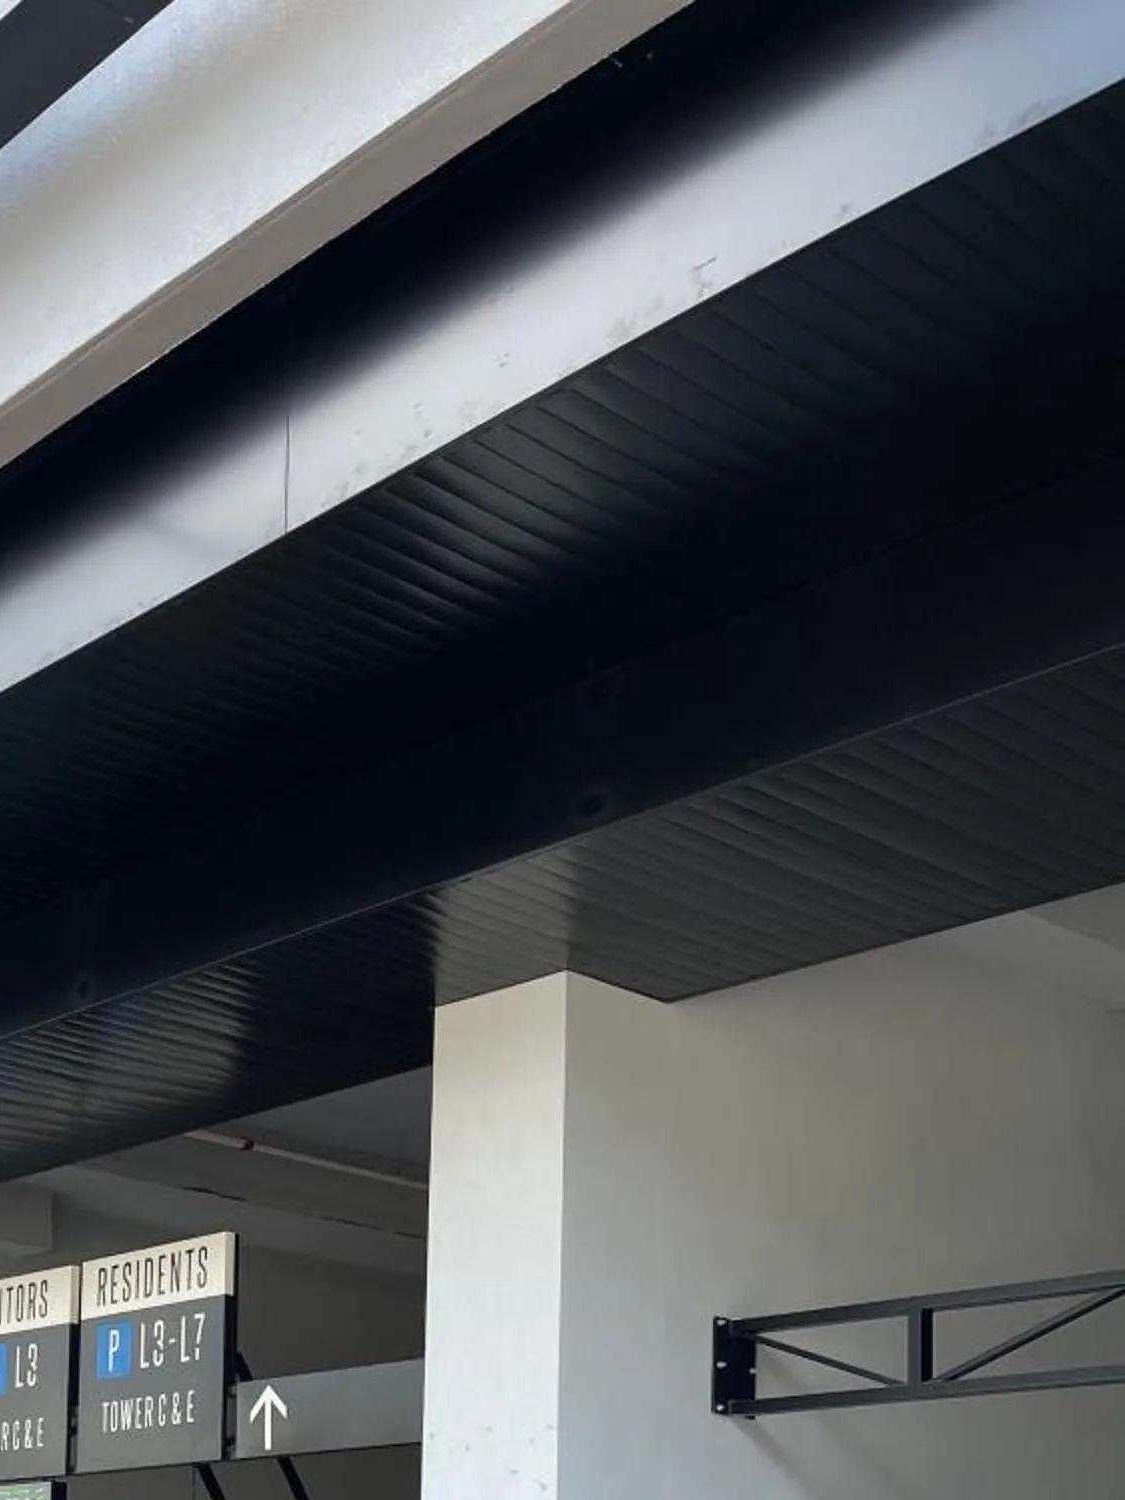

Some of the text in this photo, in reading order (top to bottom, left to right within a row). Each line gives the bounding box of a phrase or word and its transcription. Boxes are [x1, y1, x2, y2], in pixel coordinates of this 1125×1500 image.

[97, 1246, 208, 1306] RESIDENTS
[108, 1312, 206, 1373] P L3-L7
[15, 1343, 38, 1388] L3
[13, 1420, 20, 1450] C
[25, 1419, 33, 1448] &
[37, 1417, 44, 1447] E
[102, 1390, 195, 1433] TOWER C & E
